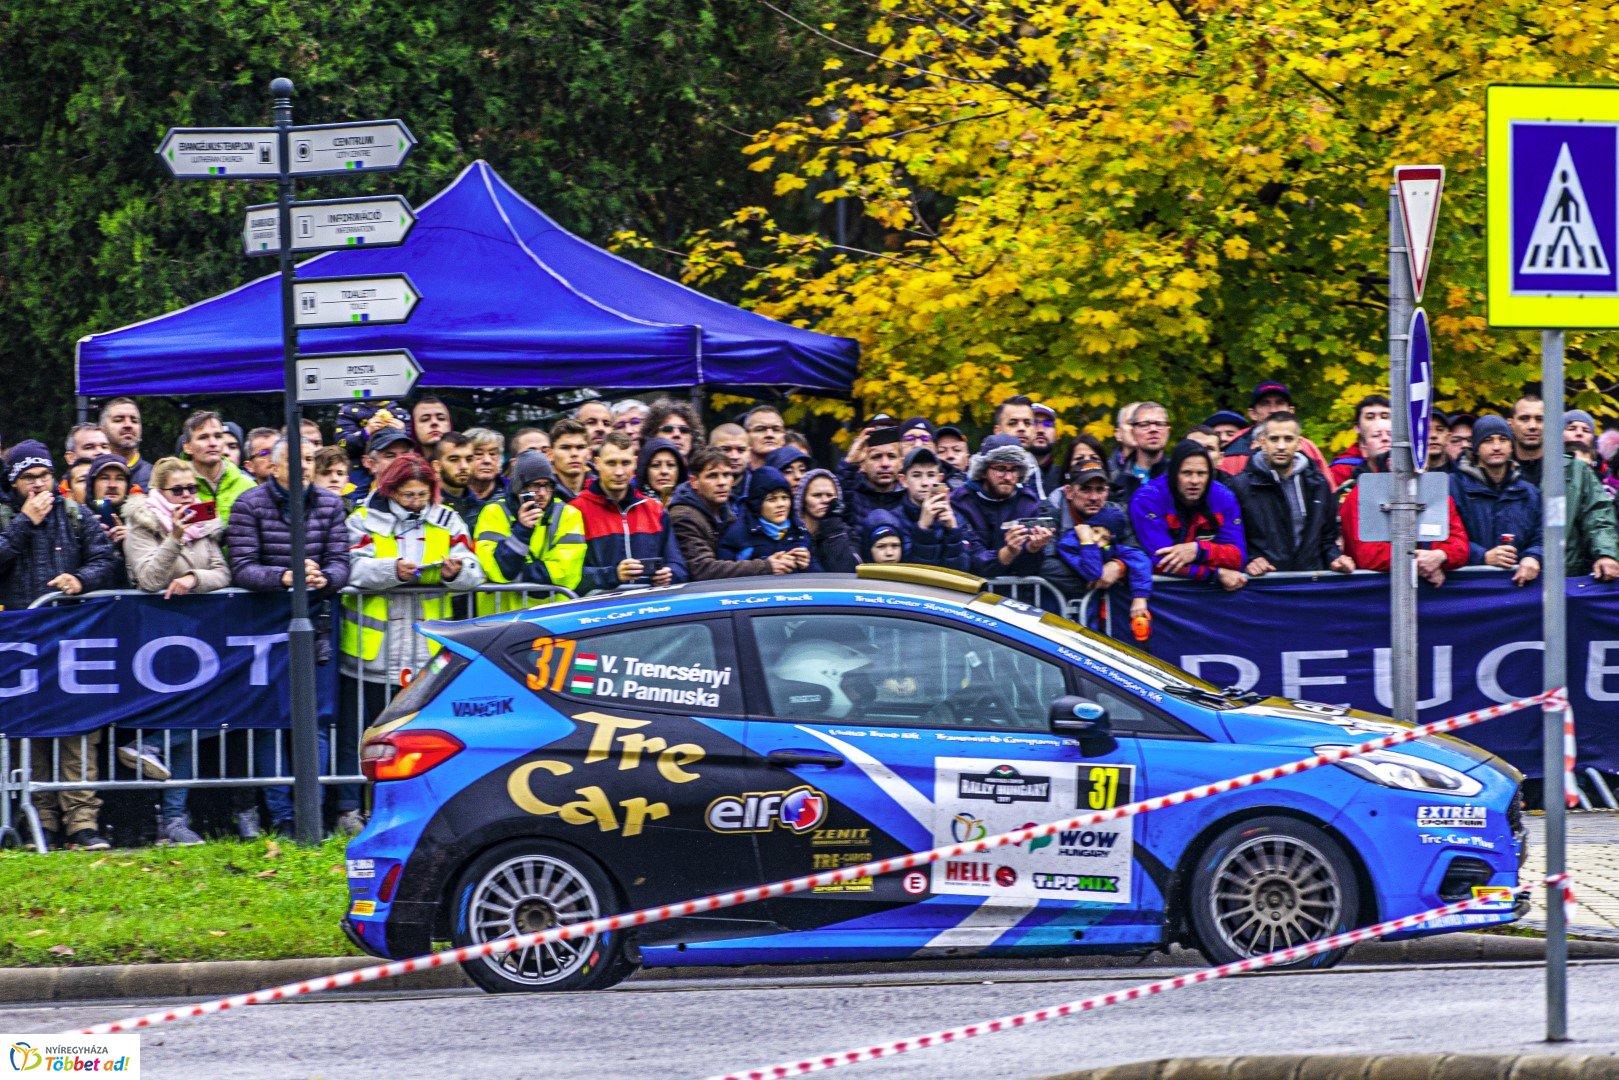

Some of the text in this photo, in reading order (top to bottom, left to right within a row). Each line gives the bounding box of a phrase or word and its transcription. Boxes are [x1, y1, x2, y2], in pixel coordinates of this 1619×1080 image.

[332, 136, 375, 147] CENTRUM
[328, 209, 382, 223] INFORMÁCIÓ
[347, 365, 376, 375] POSTA
[526, 636, 578, 692] 37
[601, 654, 732, 689] V. Trencsényi
[596, 678, 720, 708] D. Pannuska
[571, 711, 707, 784] Tre
[961, 779, 995, 795] RALLY
[996, 783, 1049, 797] HUNGARY
[1088, 767, 1120, 811] 37
[507, 759, 671, 837] Car
[709, 796, 782, 829] elf
[1417, 803, 1487, 819] EXTRÉM
[812, 828, 871, 839] ZENIT
[1060, 830, 1121, 848] WOW
[1058, 848, 1111, 858] HUNGARY
[946, 861, 991, 882] HELL
